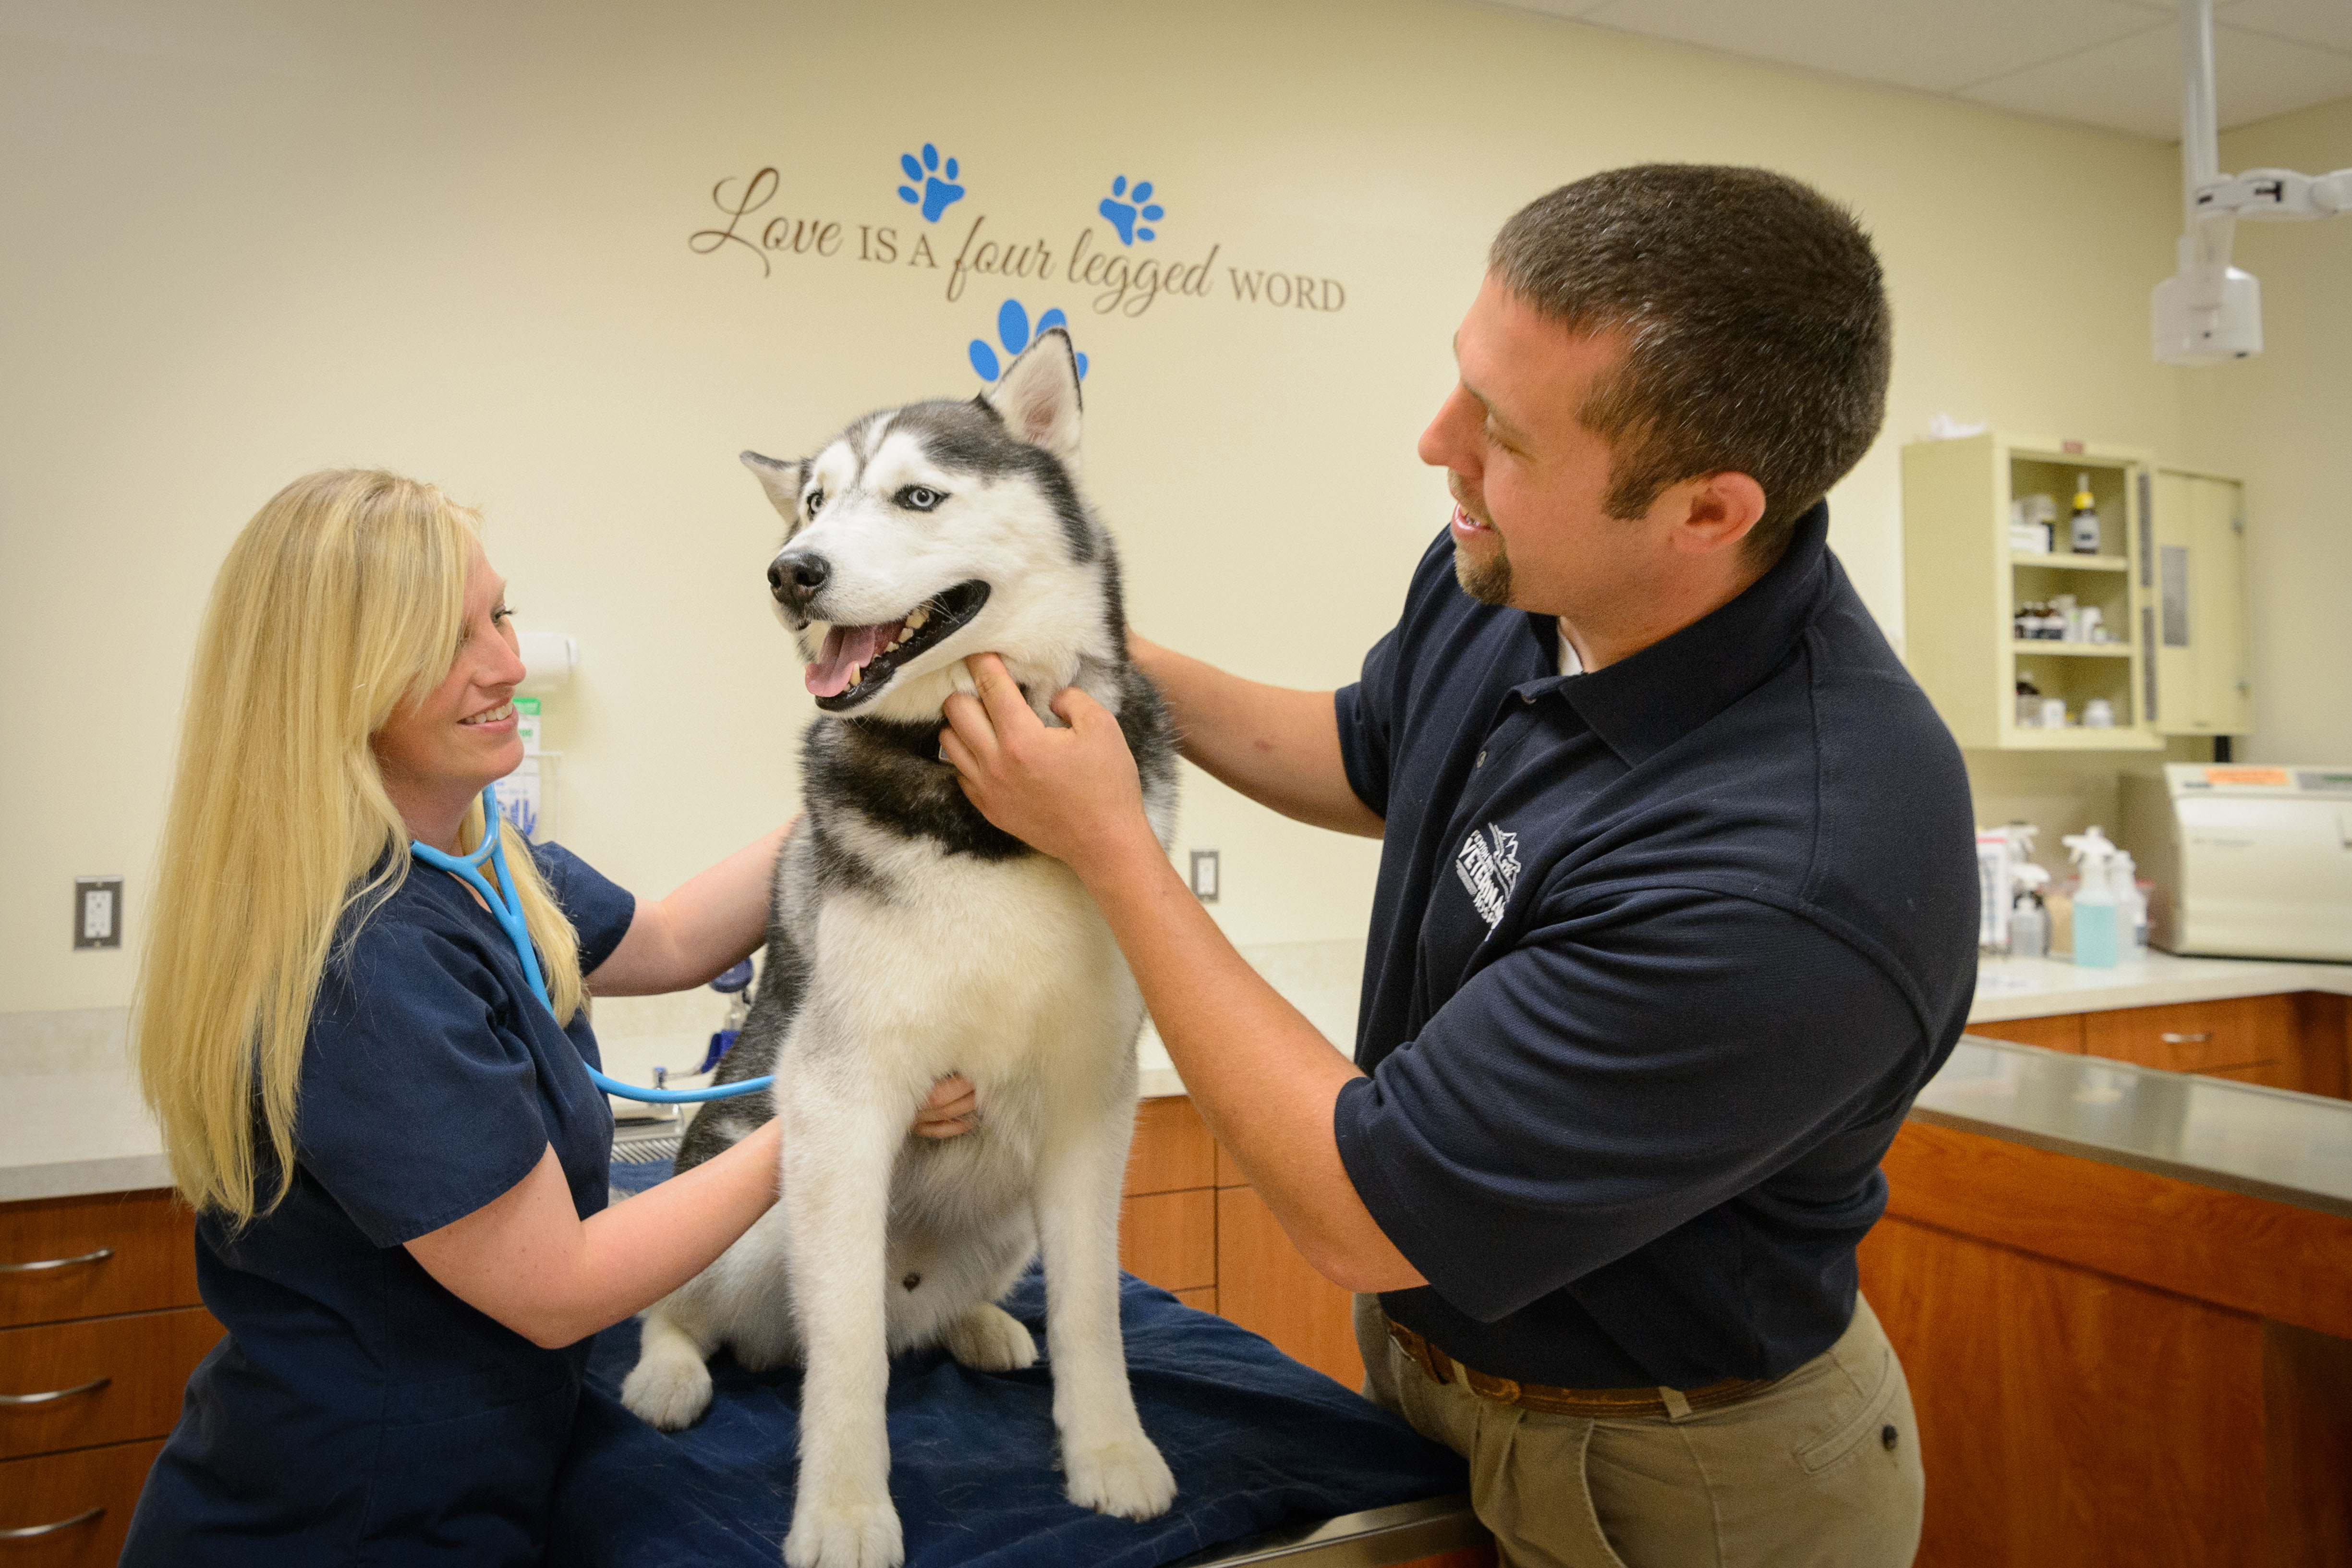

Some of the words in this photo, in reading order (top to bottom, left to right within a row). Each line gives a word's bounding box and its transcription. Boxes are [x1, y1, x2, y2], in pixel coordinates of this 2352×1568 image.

[688, 166, 841, 279] Love
[859, 225, 898, 264] IS
[908, 233, 937, 268] A
[946, 215, 1052, 303] four
[1067, 228, 1220, 318] legged
[1228, 267, 1346, 312] WORD
